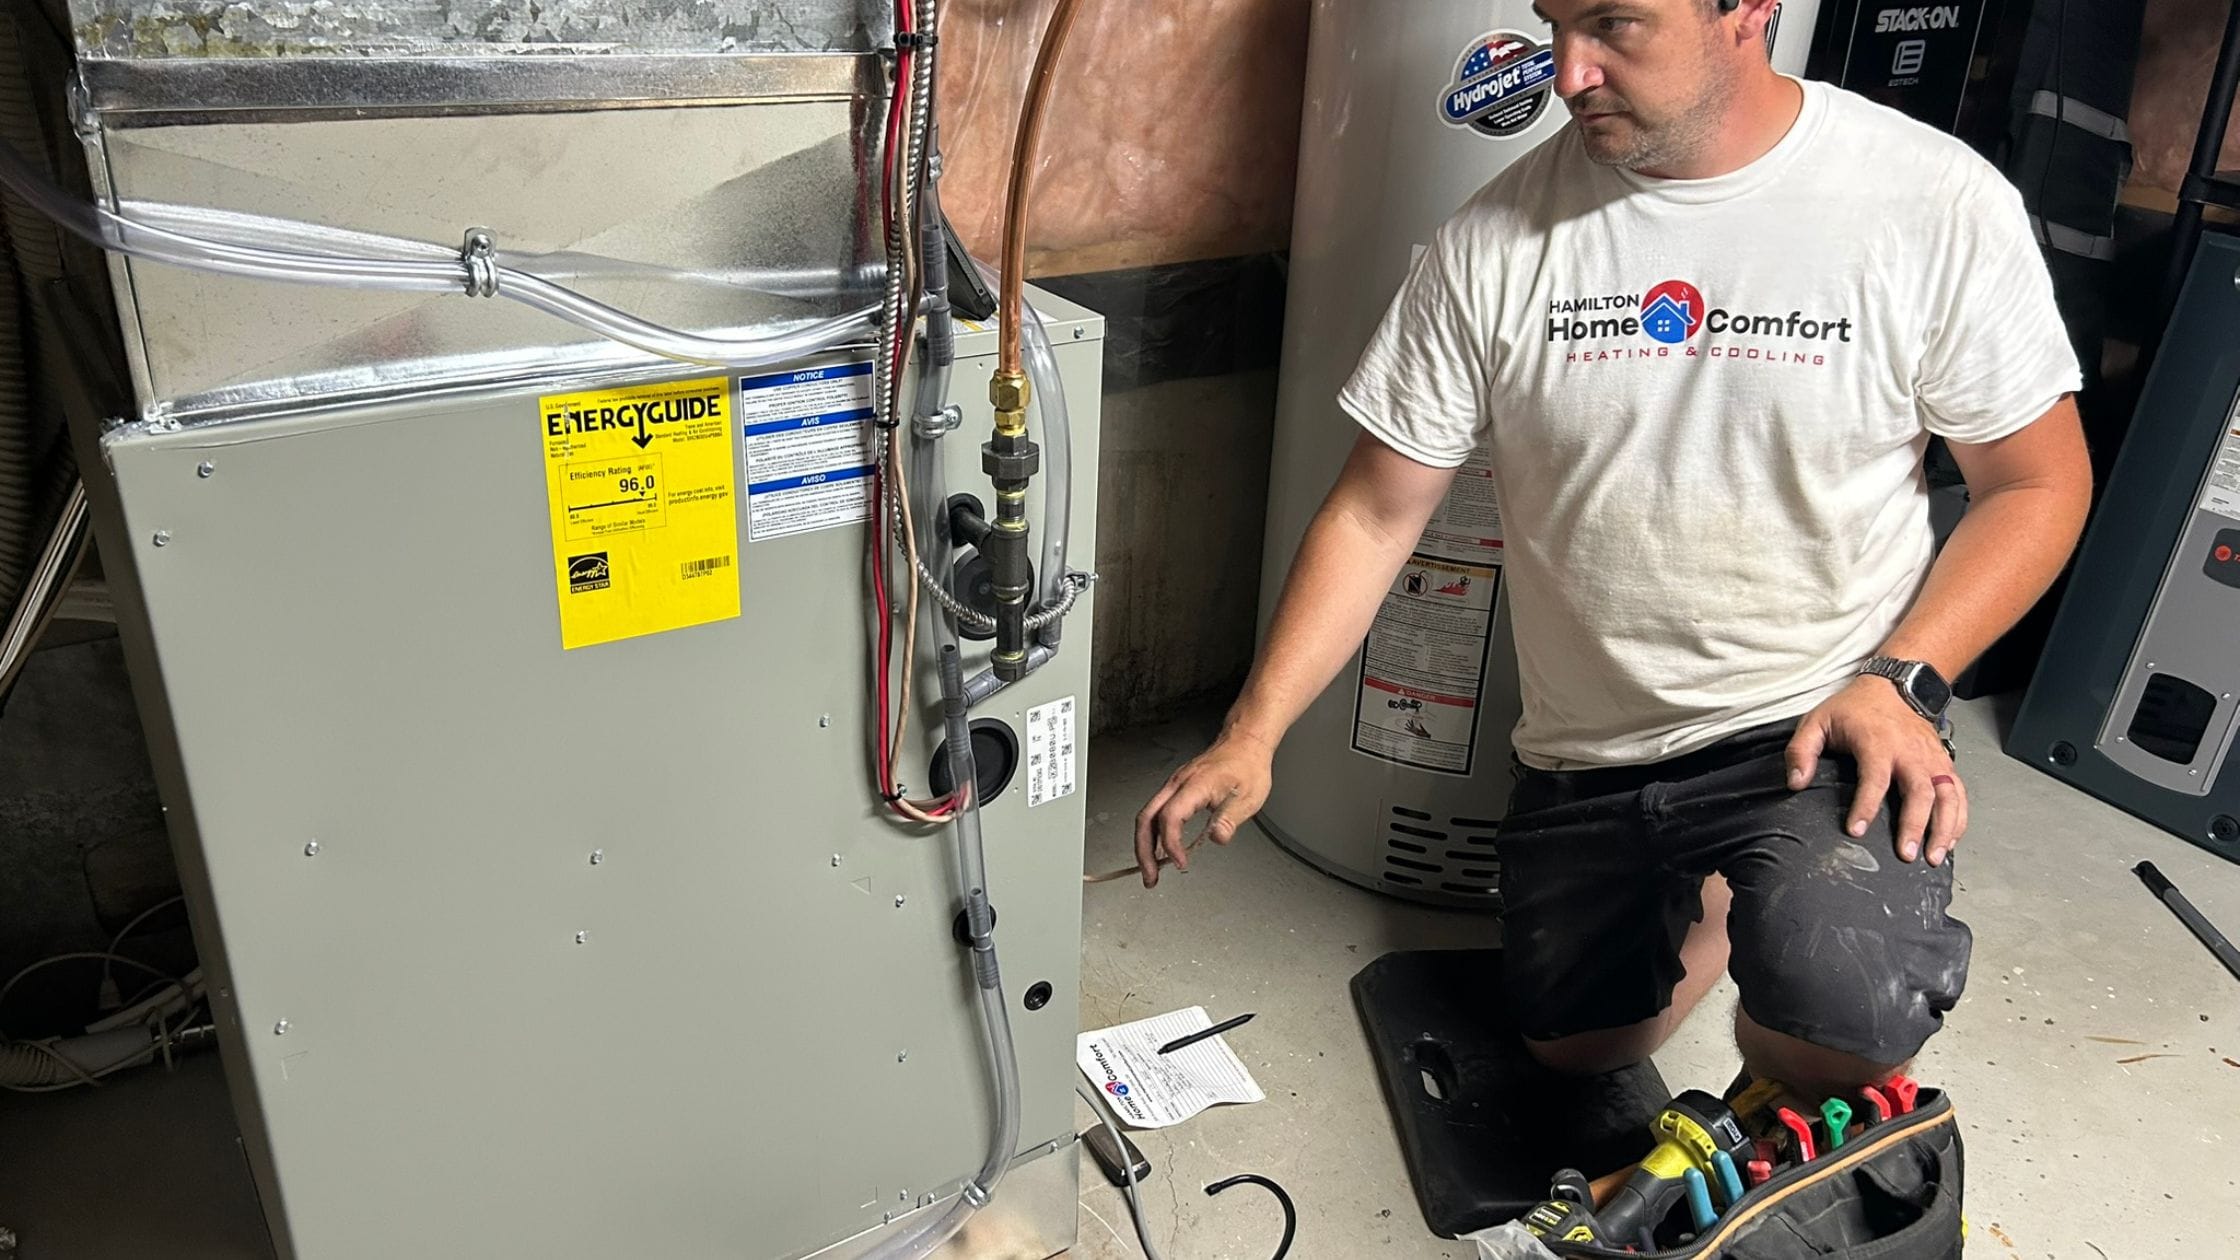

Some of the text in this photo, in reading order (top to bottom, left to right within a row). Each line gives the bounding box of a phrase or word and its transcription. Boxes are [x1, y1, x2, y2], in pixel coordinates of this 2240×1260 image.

[1875, 6, 1959, 32] STACK-ON
[1453, 67, 1520, 111] Hydrojet
[1550, 294, 1639, 313] HAMILTON
[1548, 309, 1852, 342] Home Comfort
[1566, 346, 1824, 365] HEATING & COOLING
[793, 371, 825, 383] NOTICE
[548, 394, 720, 437] ENERGYGUIDE
[801, 418, 820, 427] AVIS
[570, 468, 605, 481] Efficiency
[608, 465, 631, 476] Rating
[802, 475, 826, 486] AVISO
[620, 475, 654, 493] 96.0
[572, 584, 594, 593] ENERGY
[1089, 1044, 1117, 1081] Comfort
[1124, 1096, 1145, 1119] Home
